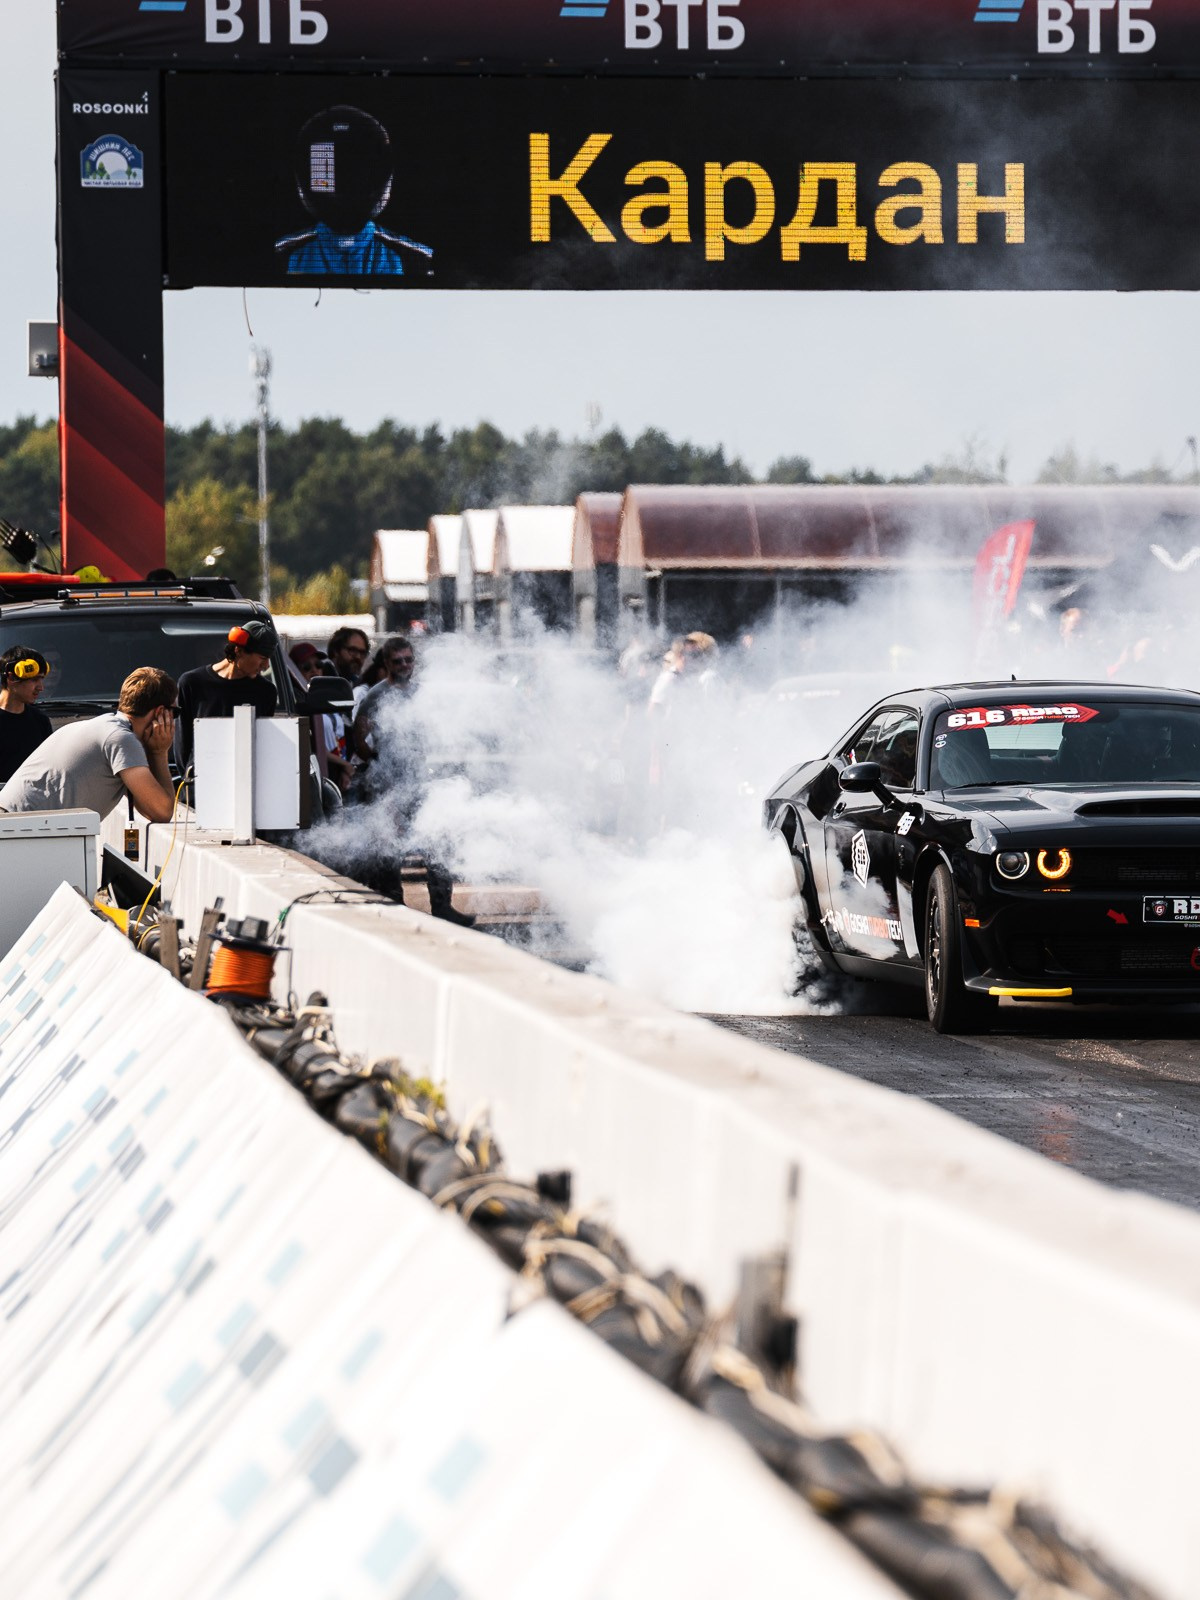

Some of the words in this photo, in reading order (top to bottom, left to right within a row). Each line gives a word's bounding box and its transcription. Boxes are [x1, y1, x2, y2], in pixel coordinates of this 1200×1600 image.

[204, 0, 329, 45] ВТБ
[623, 0, 746, 50] ВТБ
[1036, 0, 1157, 54] ВТБ
[73, 102, 149, 114] ROSGONKI
[529, 132, 1025, 262] Кардан
[947, 709, 1005, 728] 616
